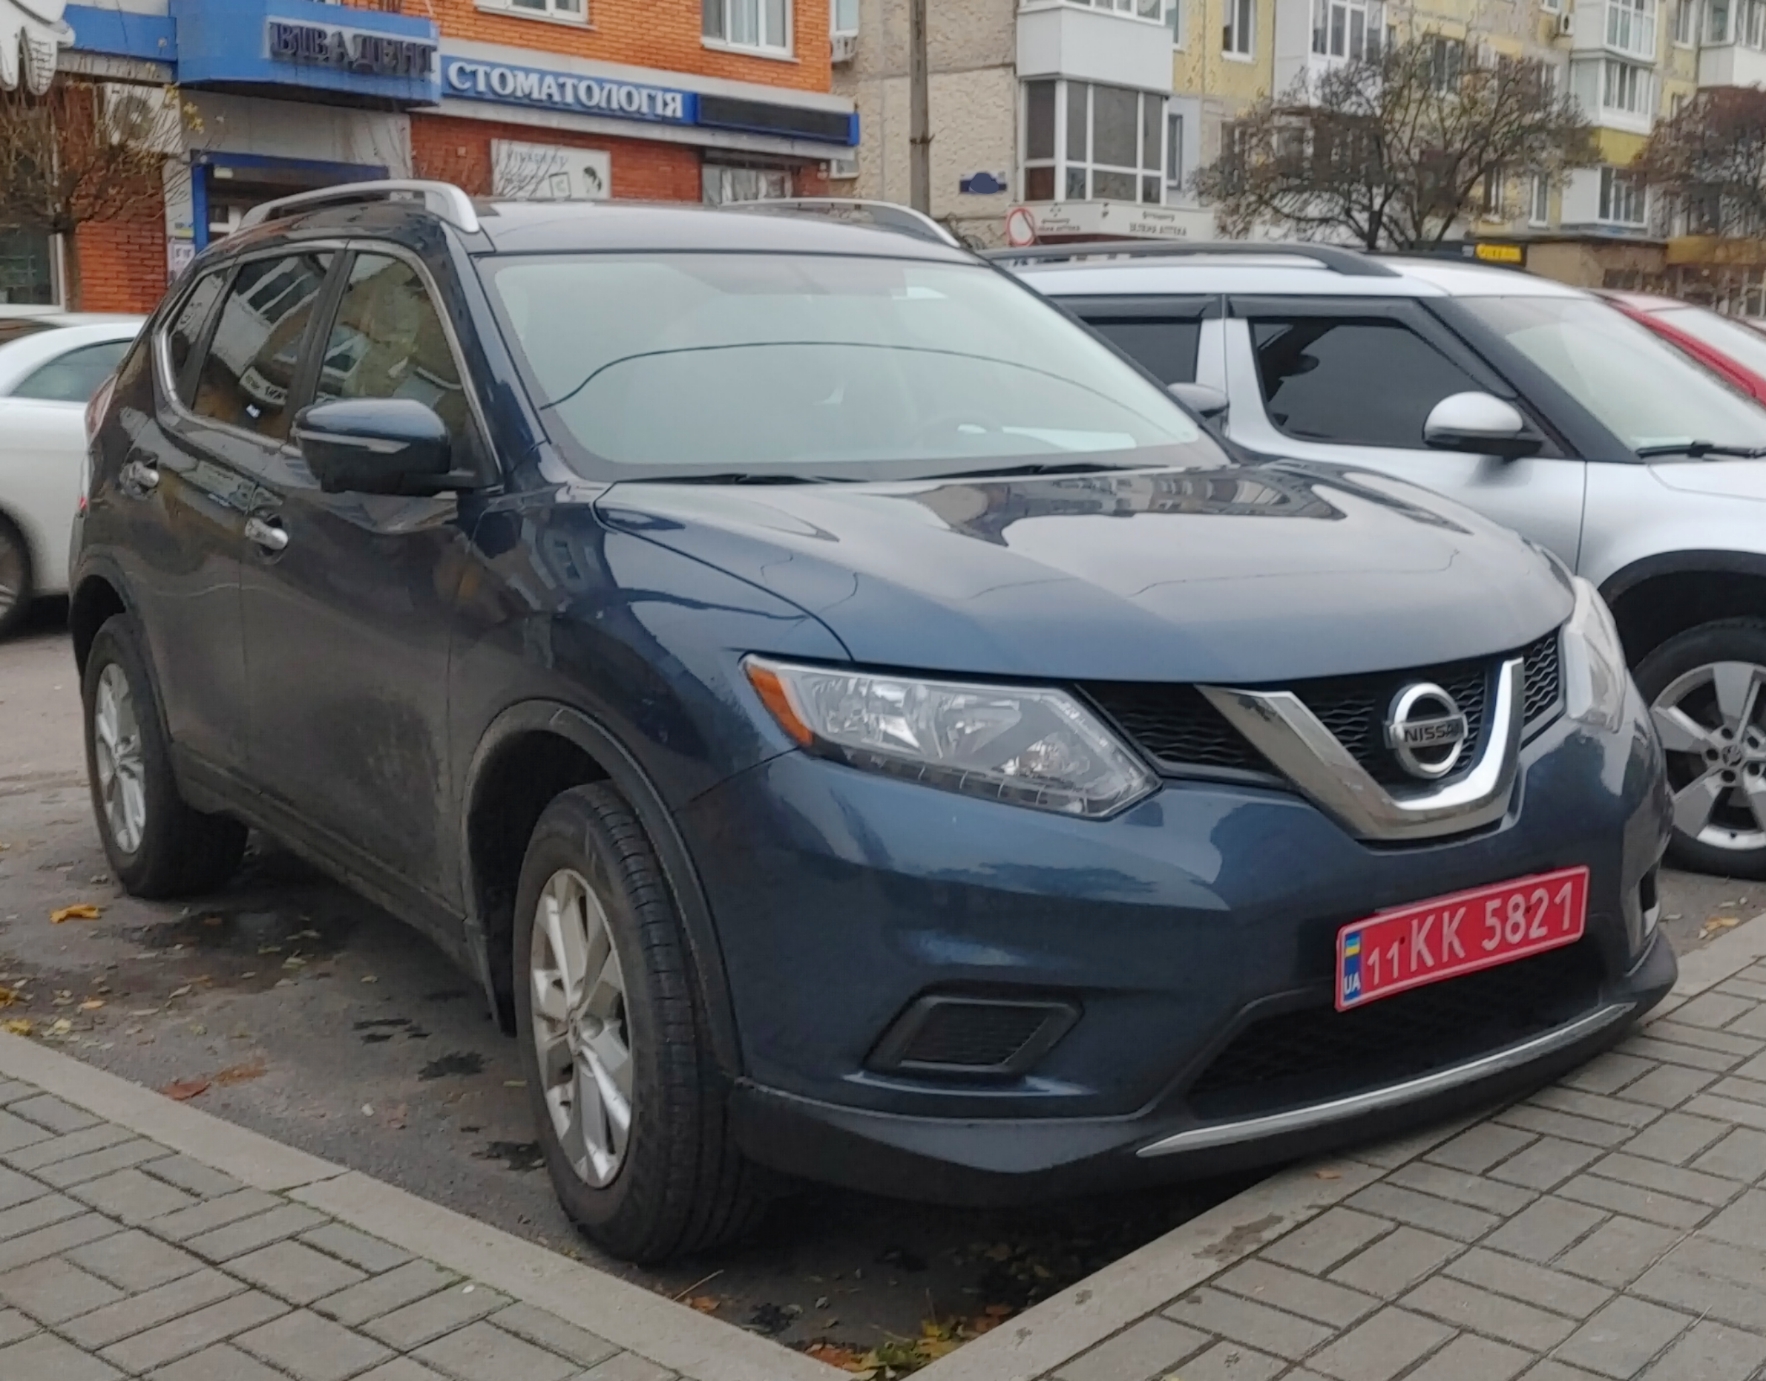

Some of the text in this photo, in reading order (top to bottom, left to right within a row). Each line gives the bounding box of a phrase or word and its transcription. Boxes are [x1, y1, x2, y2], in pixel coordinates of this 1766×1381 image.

[448, 61, 683, 118] СТОМАТОЛОГІЯ
[1404, 721, 1463, 742] NISSAN
[1481, 881, 1573, 951] 5821
[1343, 974, 1361, 995] UA
